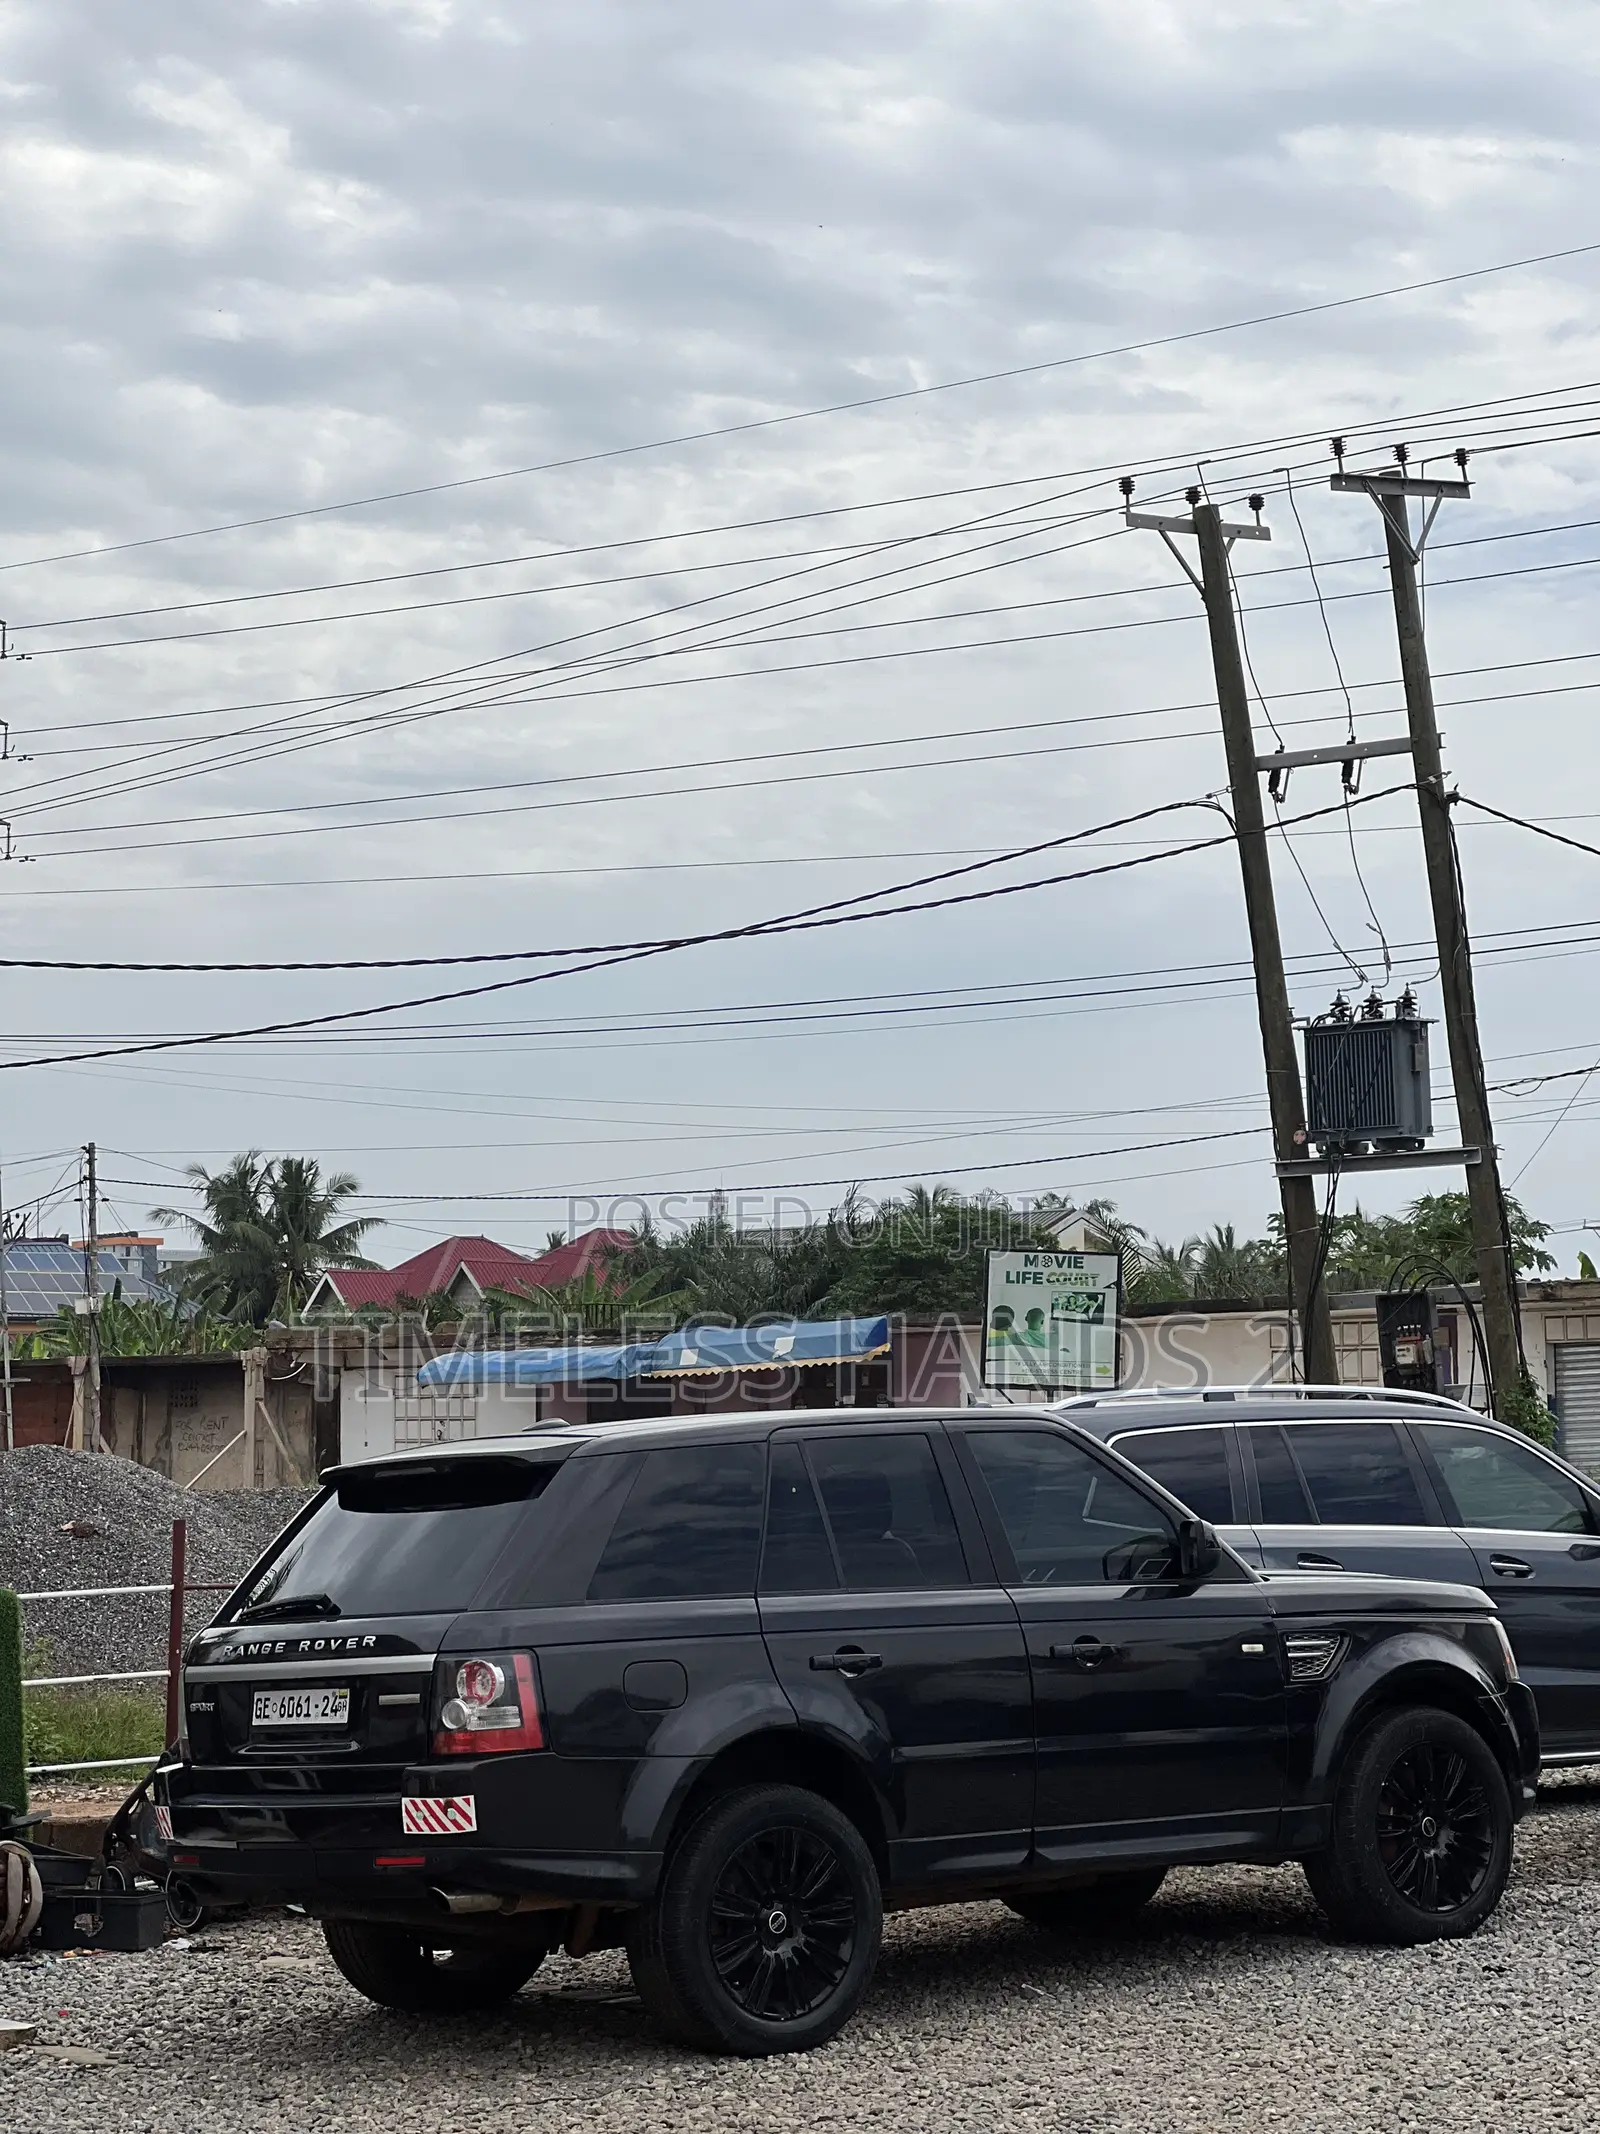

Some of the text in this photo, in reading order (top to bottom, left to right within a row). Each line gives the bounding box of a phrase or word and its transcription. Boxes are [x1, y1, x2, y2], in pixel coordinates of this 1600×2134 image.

[1005, 1270, 1100, 1287] LIFE COURT
[199, 1414, 230, 1431] RENT
[223, 1635, 377, 1656] RANGE ROVER
